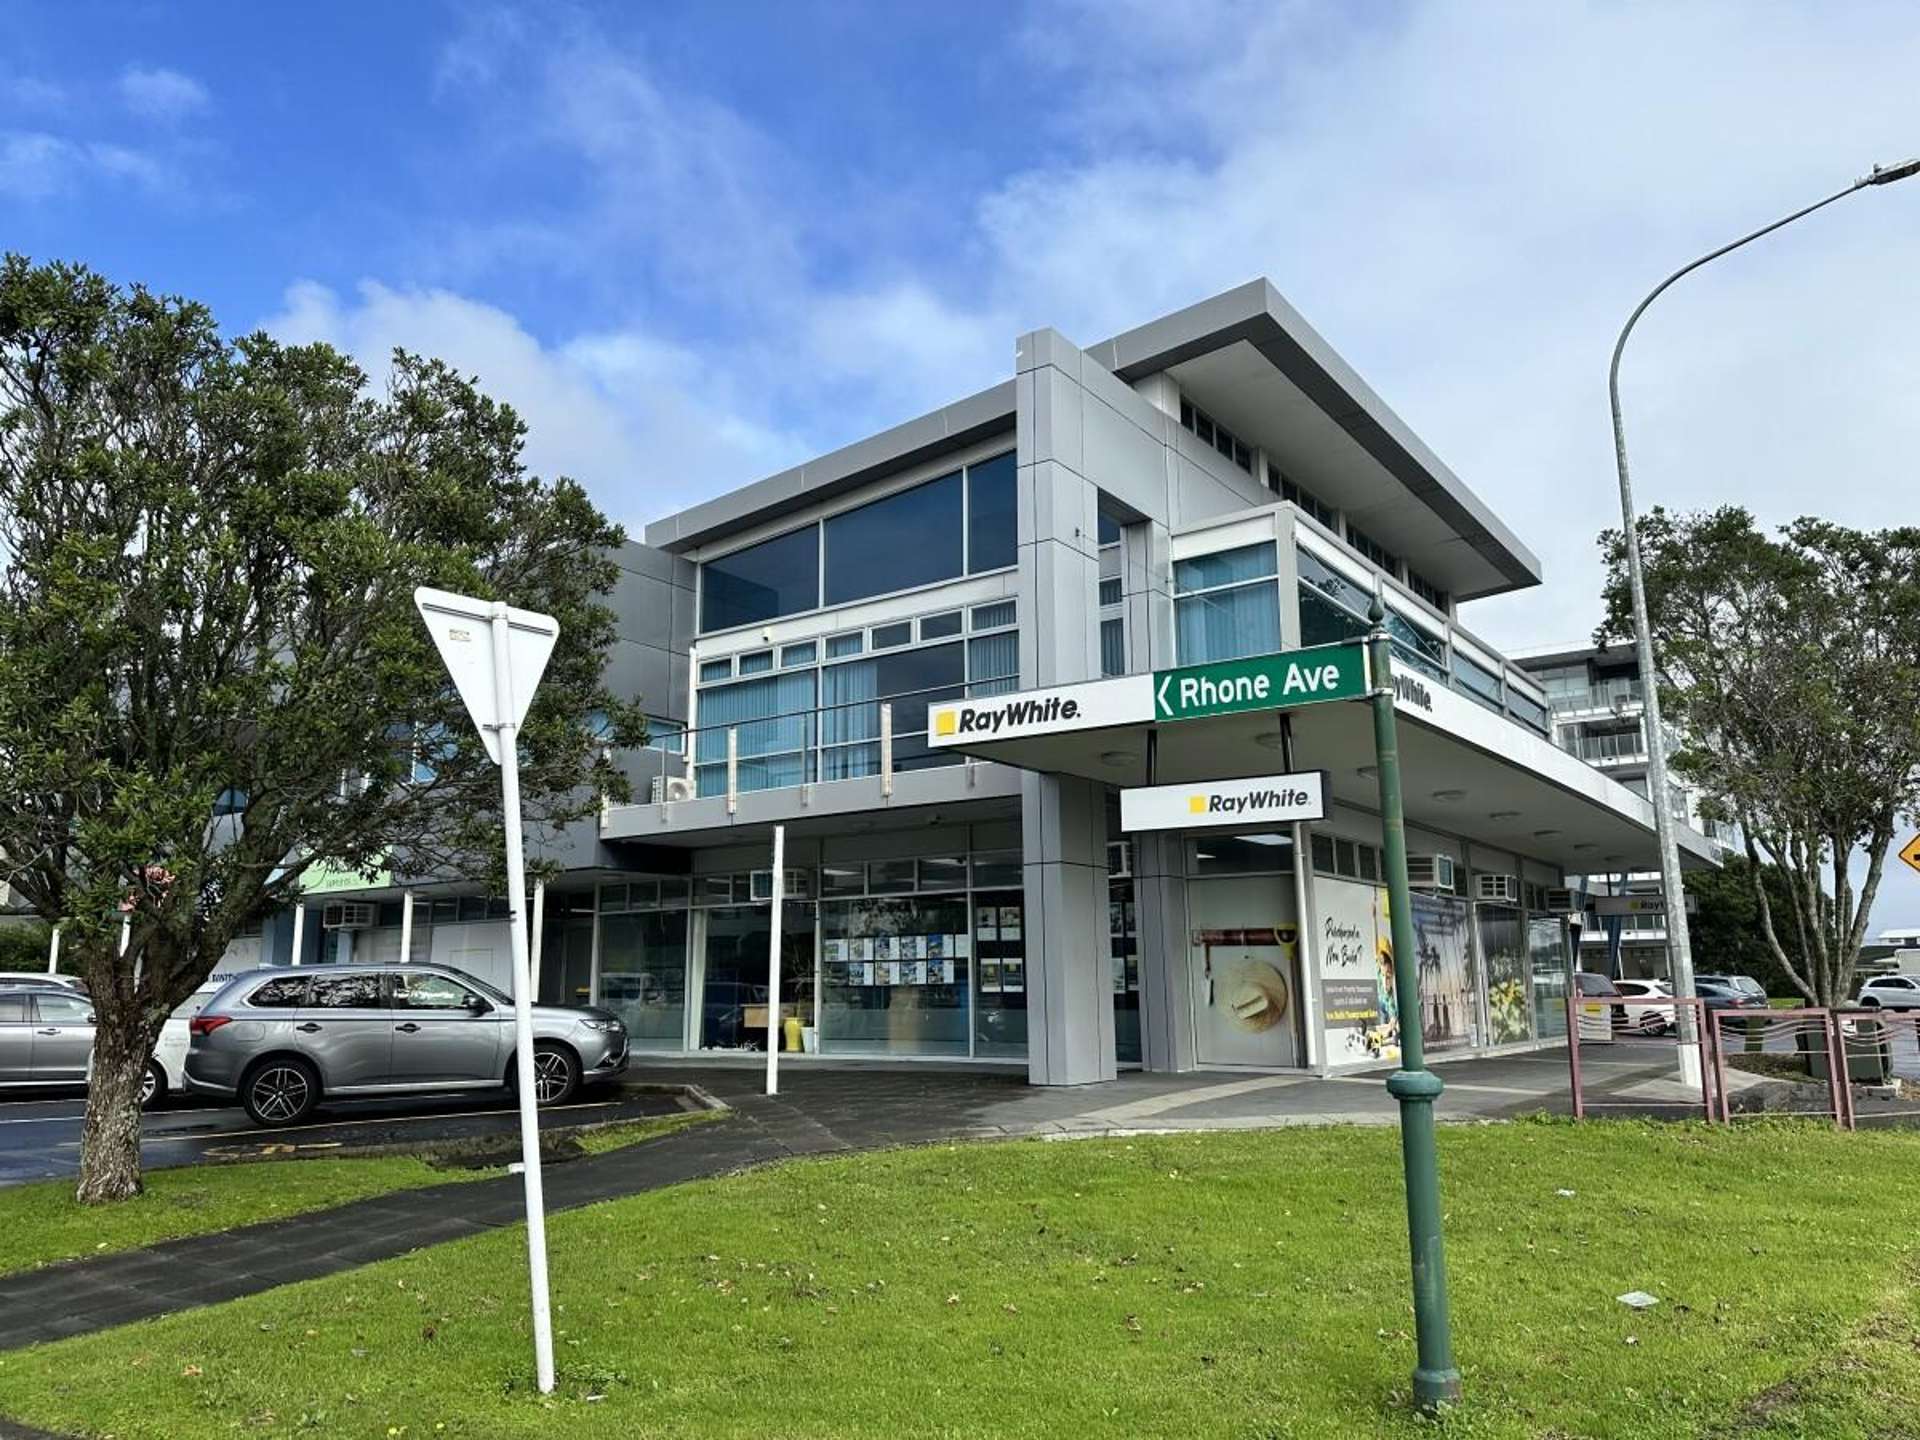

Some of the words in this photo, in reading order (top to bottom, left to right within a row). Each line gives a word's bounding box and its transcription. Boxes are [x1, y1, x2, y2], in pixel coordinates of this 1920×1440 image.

[1180, 674, 1270, 709] Rhone
[1283, 663, 1340, 696] Ave
[1391, 674, 1433, 713] yWhite.
